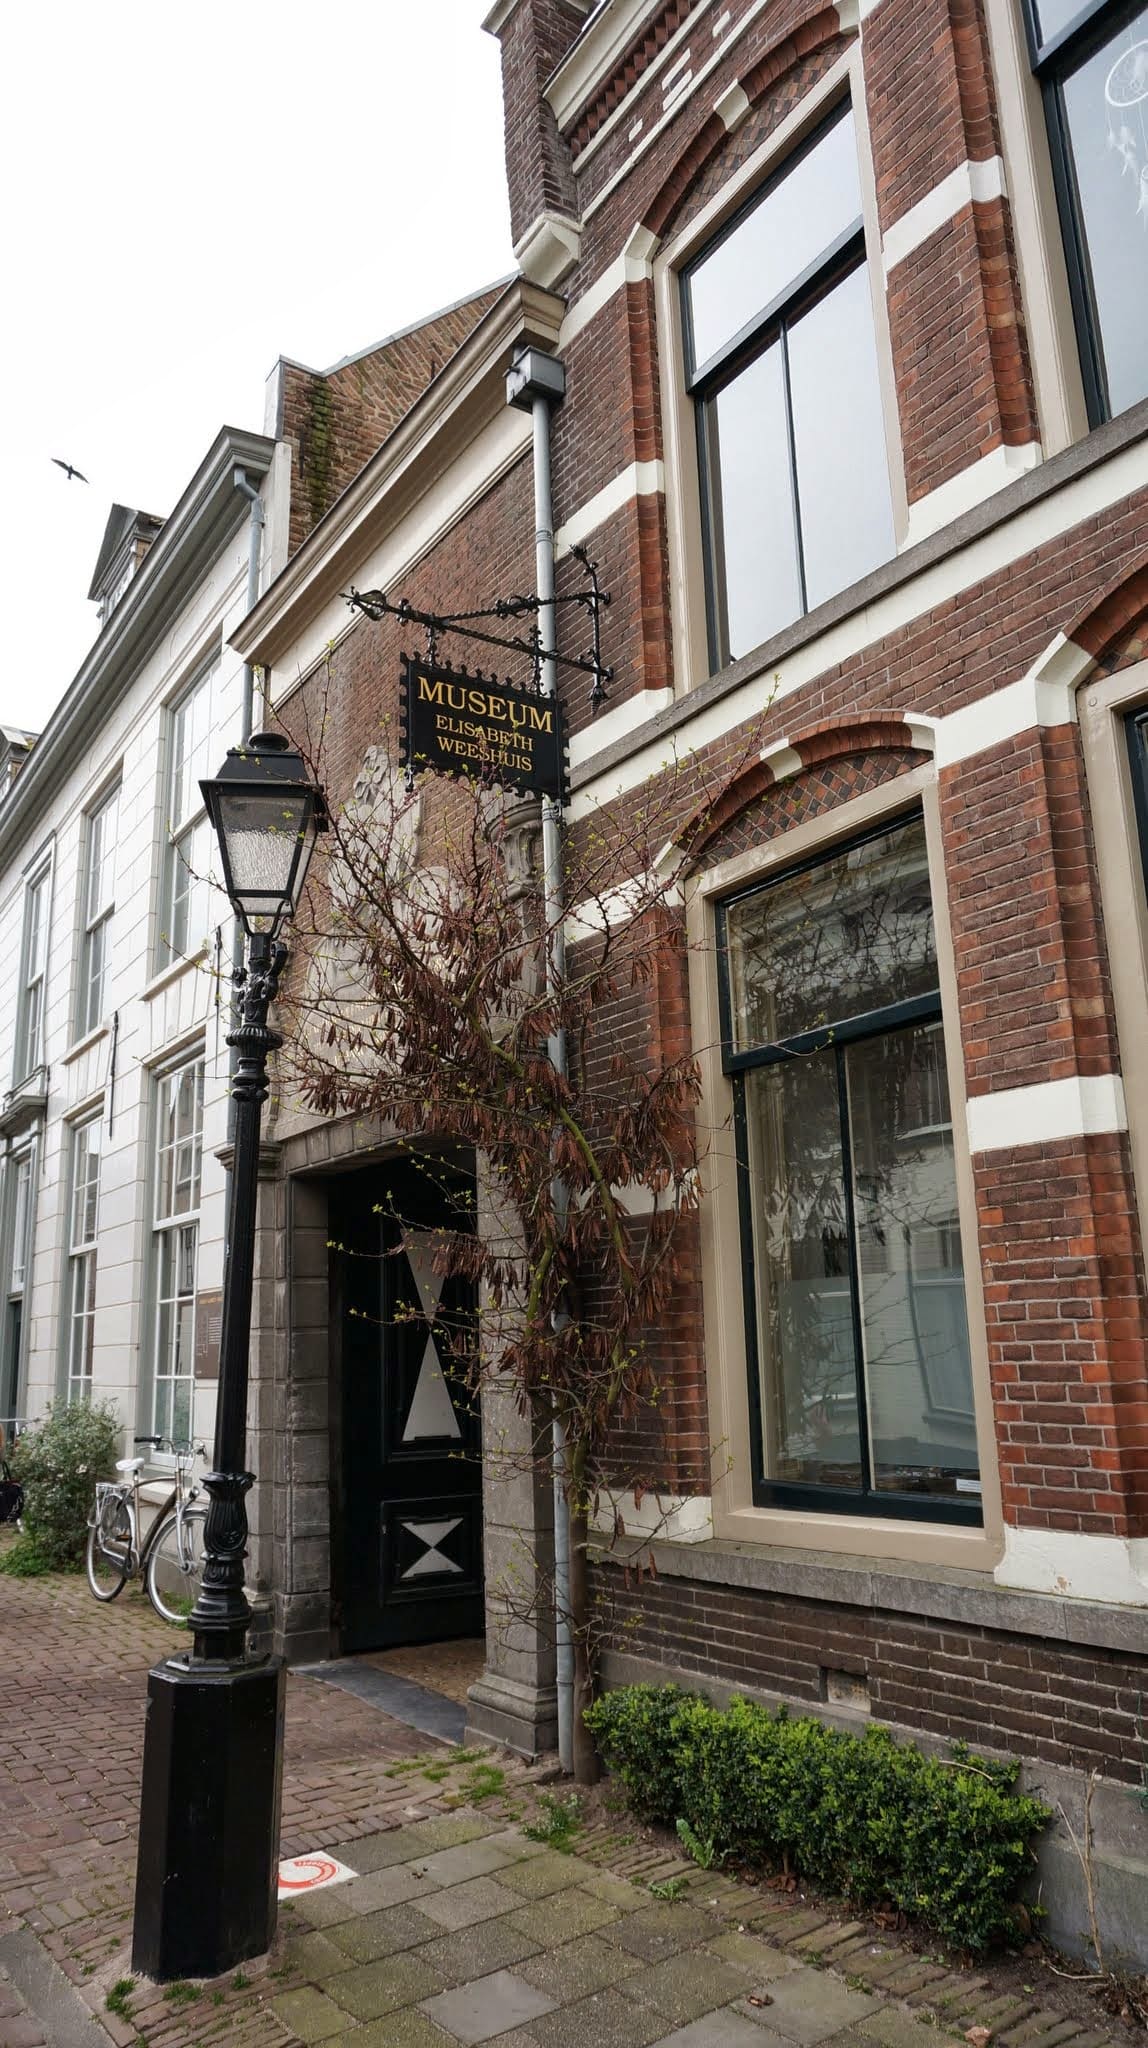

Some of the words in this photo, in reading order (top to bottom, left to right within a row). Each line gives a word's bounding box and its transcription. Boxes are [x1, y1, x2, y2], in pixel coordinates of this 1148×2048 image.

[417, 676, 553, 733] MUSEUM
[435, 714, 533, 752] ELISABETH
[436, 735, 532, 771] WEESHUIS
